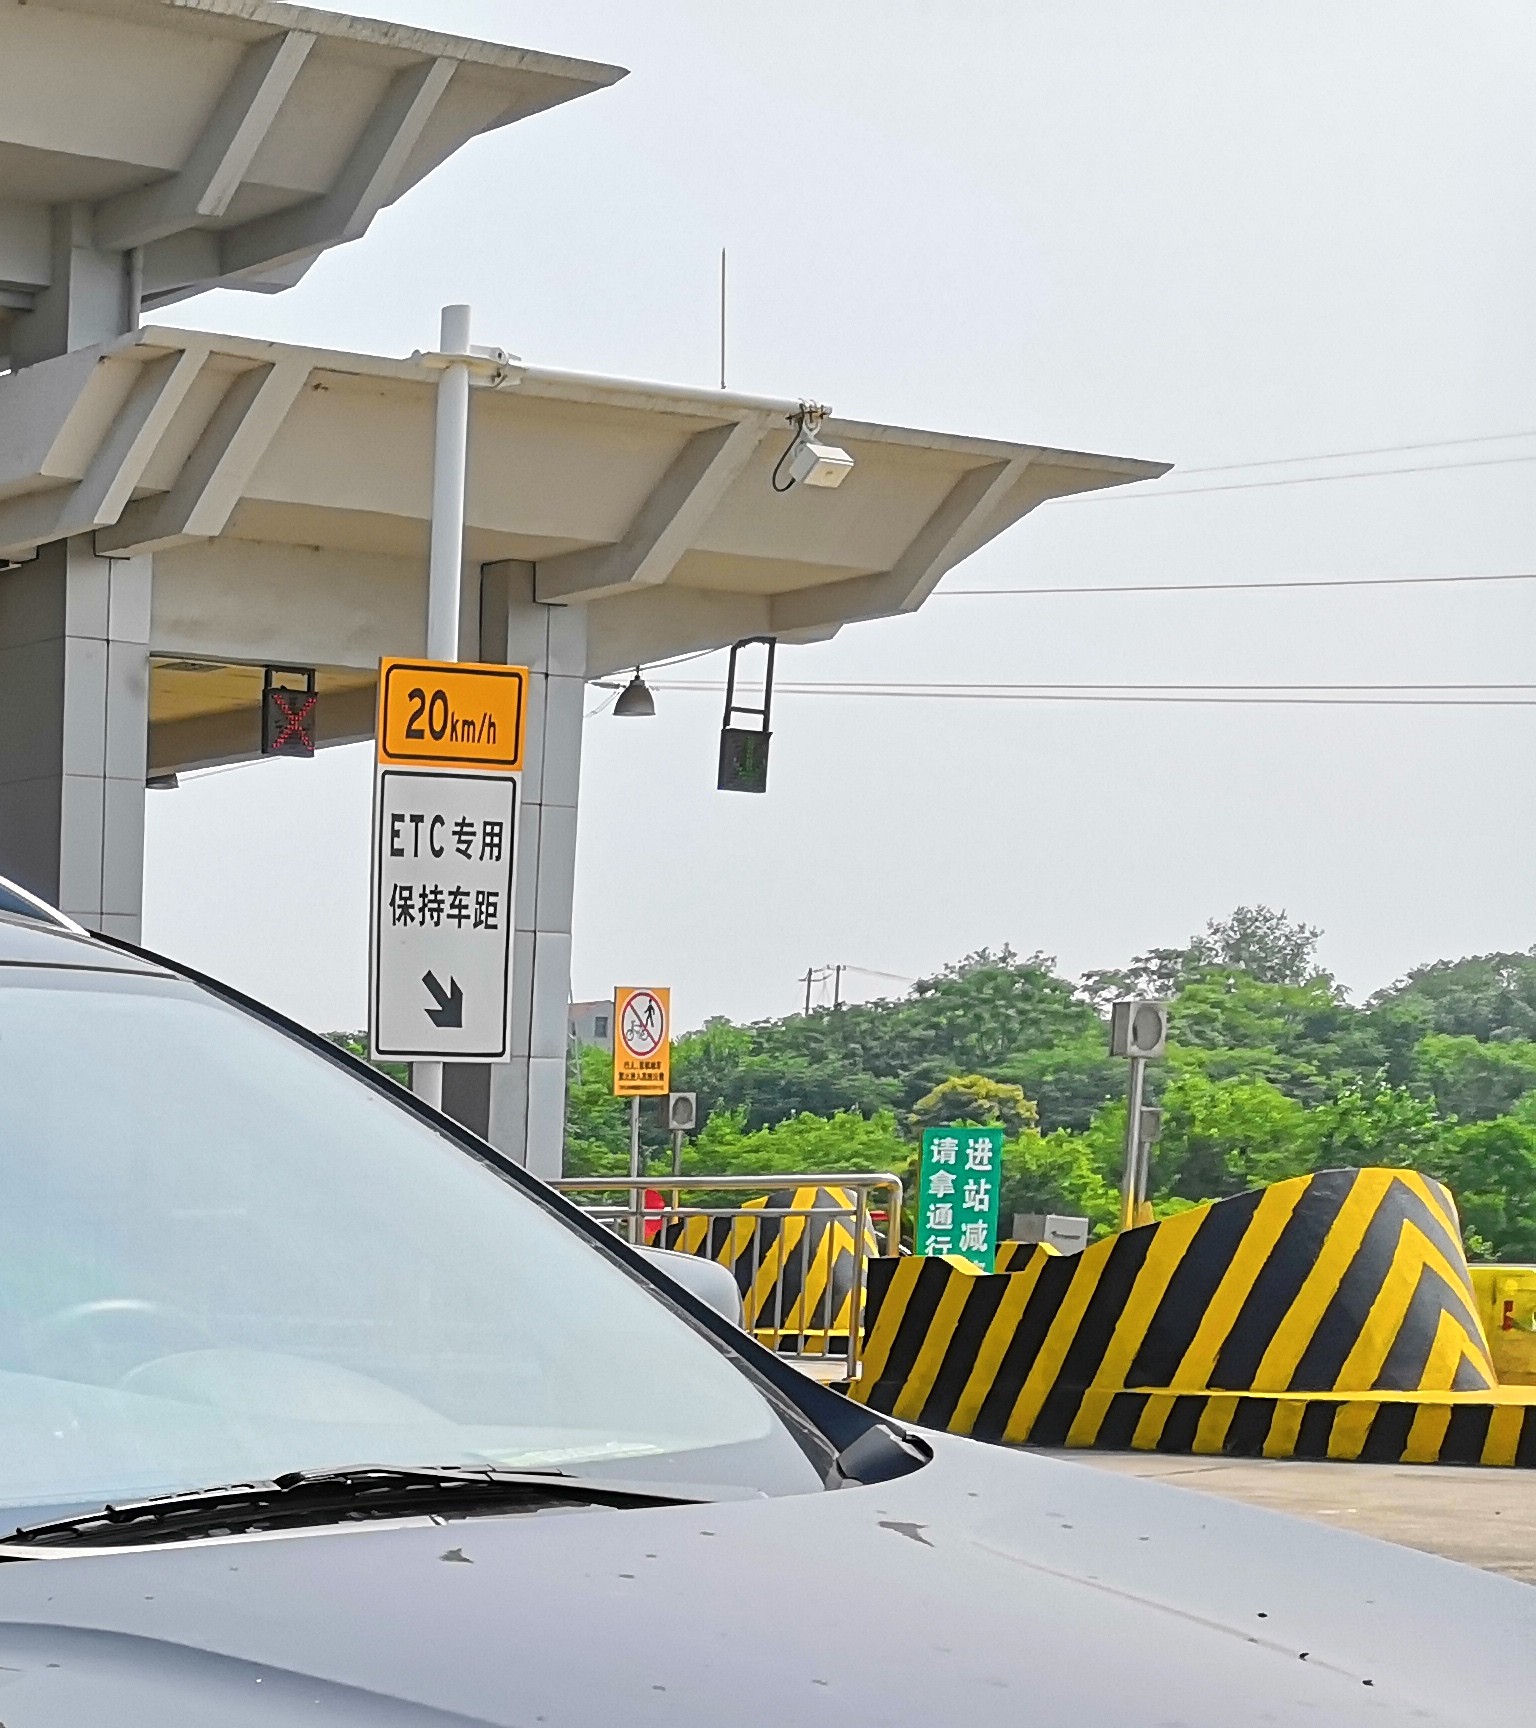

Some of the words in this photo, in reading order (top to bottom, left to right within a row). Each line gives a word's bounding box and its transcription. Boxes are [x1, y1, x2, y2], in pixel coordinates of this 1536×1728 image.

[405, 687, 497, 745] 20km/h
[389, 883, 501, 930] 保持车距
